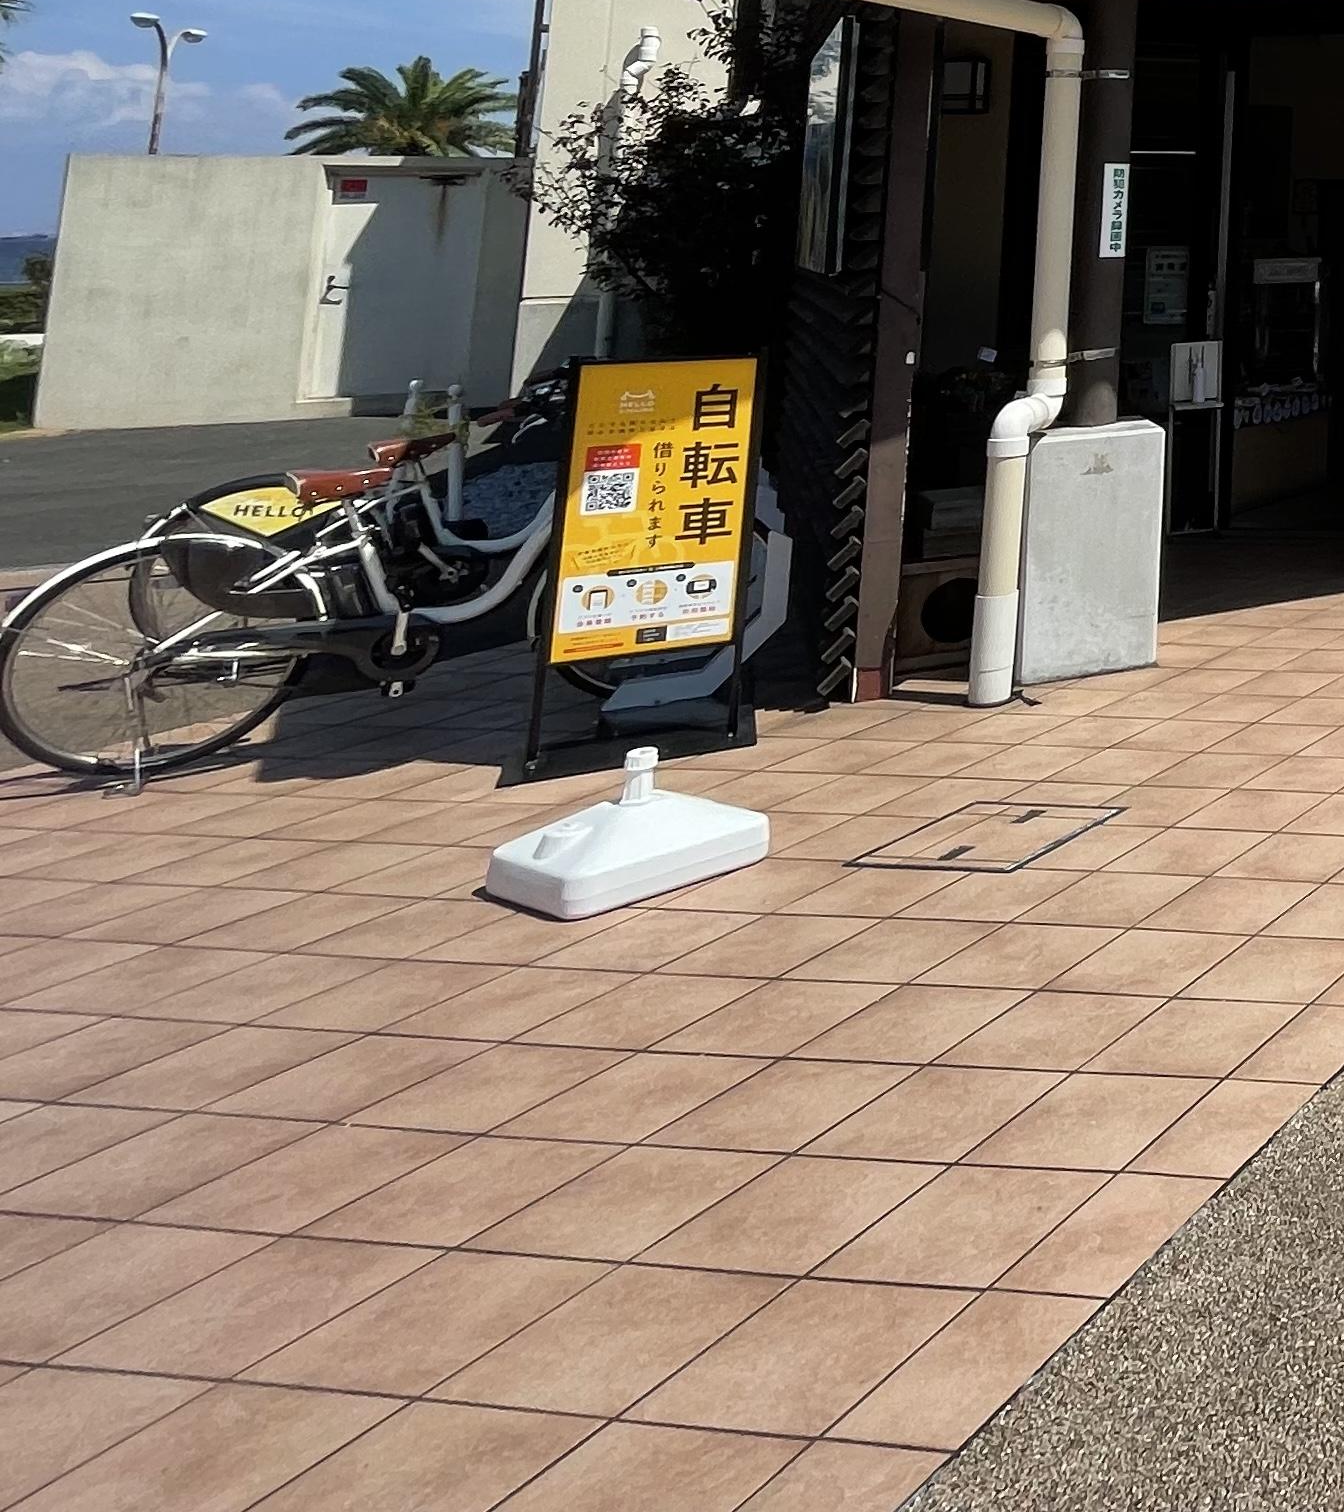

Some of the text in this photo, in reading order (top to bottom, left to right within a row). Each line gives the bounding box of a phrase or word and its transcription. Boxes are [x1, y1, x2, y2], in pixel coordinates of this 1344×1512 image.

[233, 504, 305, 518] HELLO
[645, 441, 675, 549] 借りられます
[674, 383, 740, 546] 自転車
